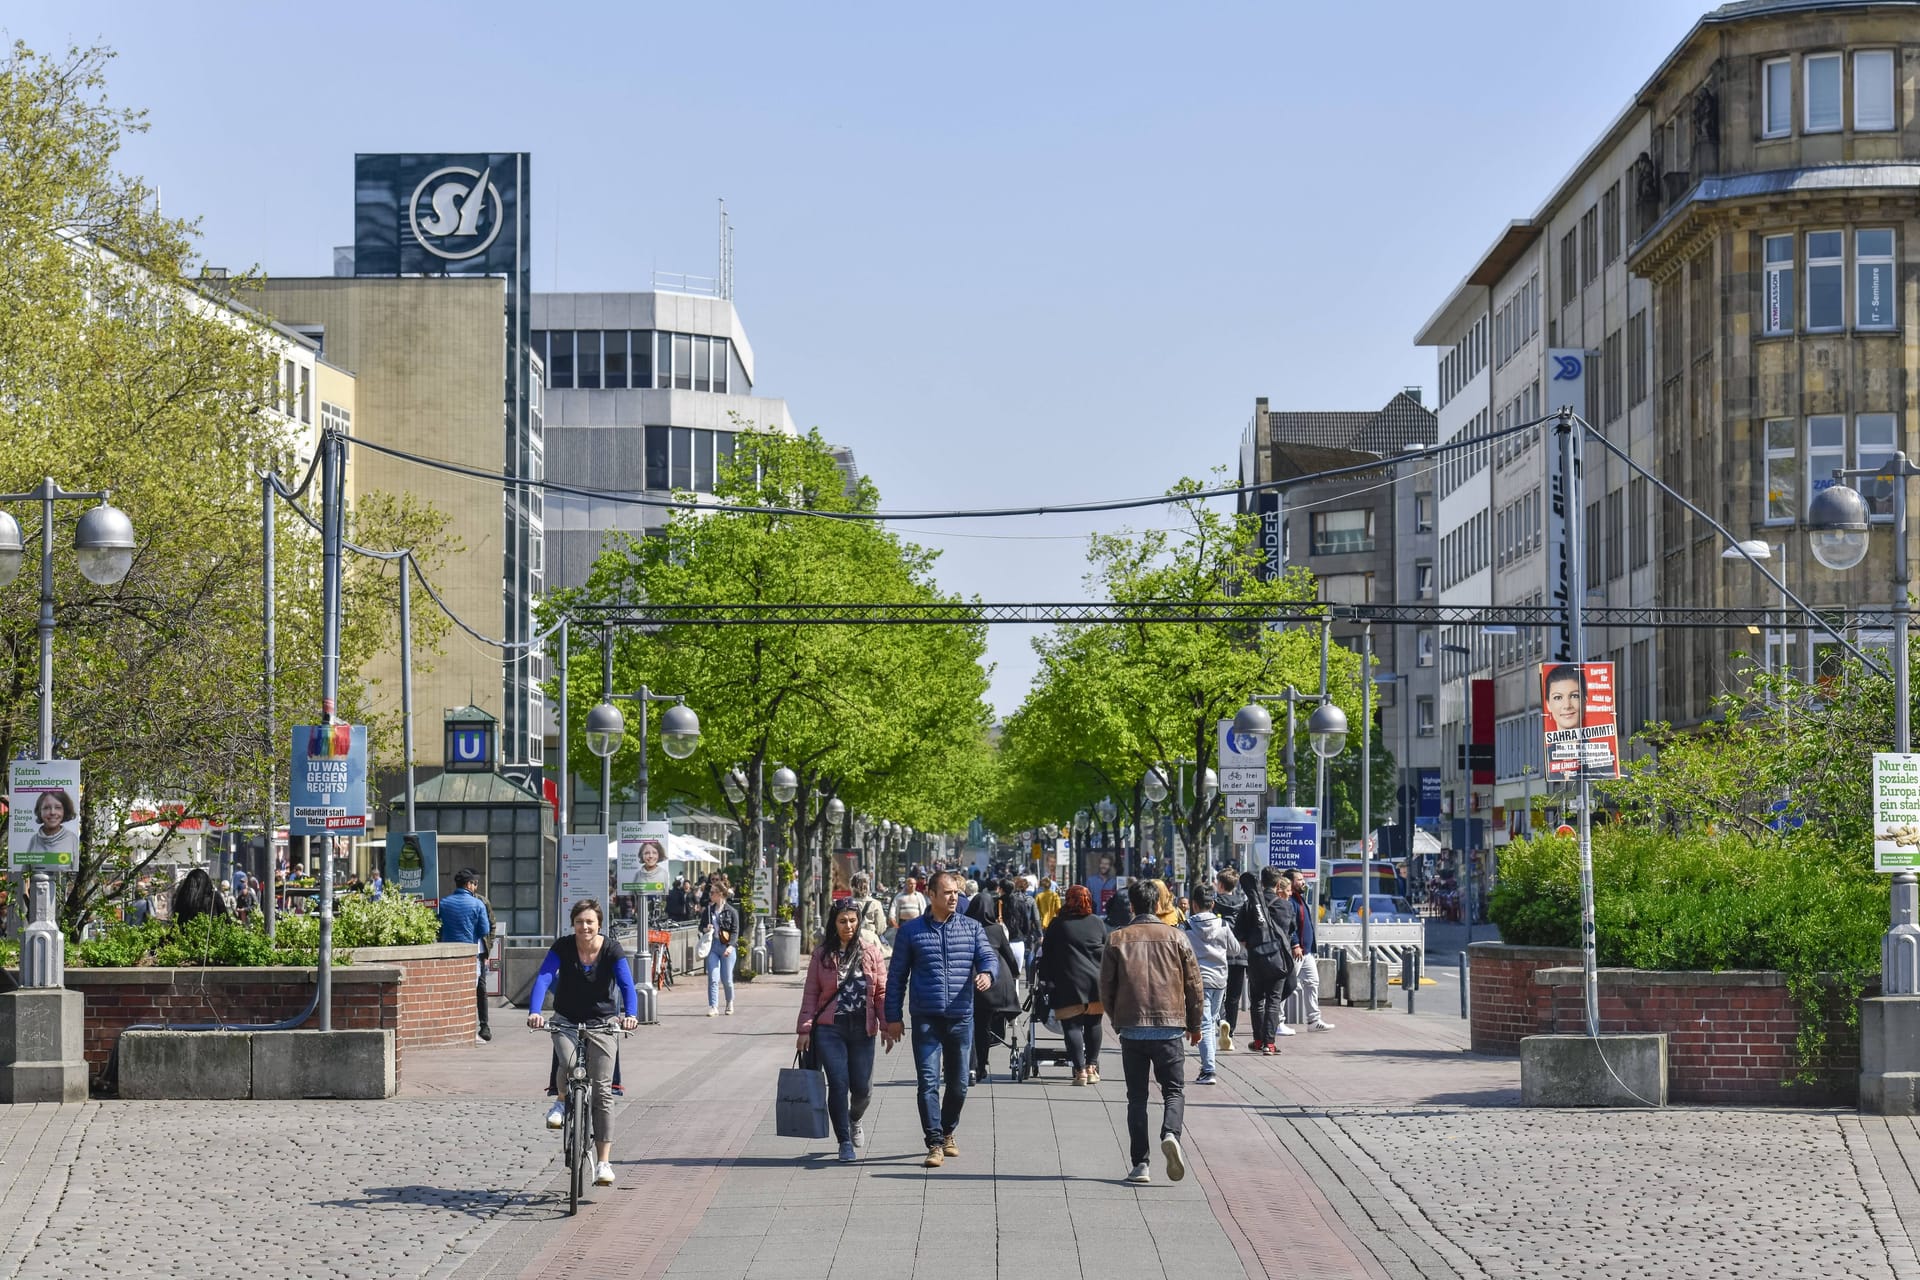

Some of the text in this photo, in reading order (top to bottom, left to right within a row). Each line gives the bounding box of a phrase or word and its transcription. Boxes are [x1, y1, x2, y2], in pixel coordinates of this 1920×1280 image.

[1871, 267, 1880, 308] Seminare
[1771, 273, 1779, 327] SYMPLASSON
[1871, 313, 1880, 321] IT
[1813, 479, 1835, 490] ZAG
[1265, 511, 1278, 582] SANDER
[1547, 725, 1614, 743] SAHRA KOMMT!
[459, 734, 480, 759] U
[307, 762, 348, 772] TU WAS
[1879, 760, 1917, 771] Nur ein
[15, 768, 41, 776] Katrin
[307, 772, 348, 782] GEGEN
[14, 778, 73, 788] Langensiepen
[1879, 773, 1918, 784] soziales
[1879, 785, 1916, 799] Europa
[1880, 799, 1897, 810] ein
[295, 808, 328, 816] Solidarität
[307, 817, 325, 825] Hetze
[328, 818, 339, 827] DIE
[1880, 811, 1919, 825] Europa.
